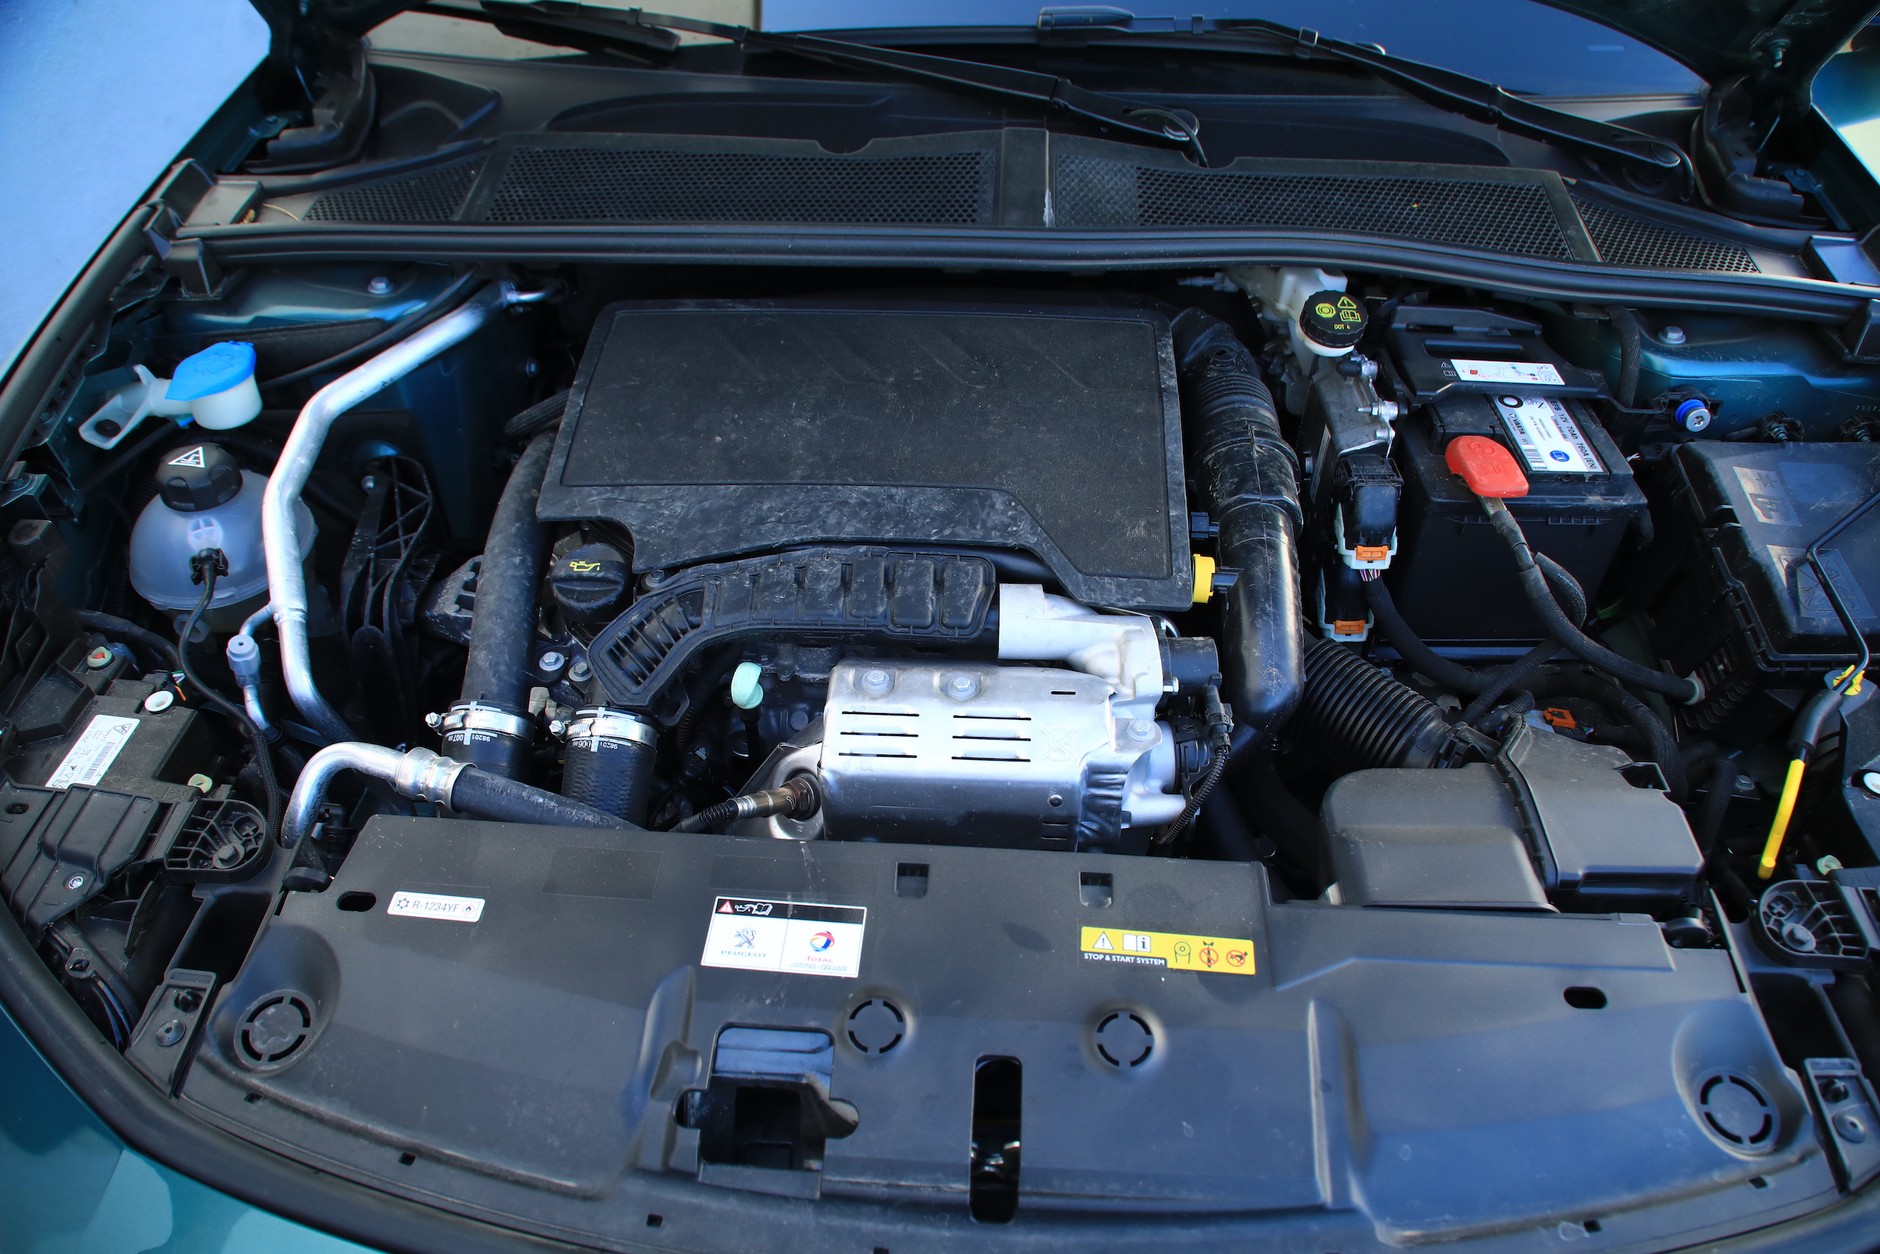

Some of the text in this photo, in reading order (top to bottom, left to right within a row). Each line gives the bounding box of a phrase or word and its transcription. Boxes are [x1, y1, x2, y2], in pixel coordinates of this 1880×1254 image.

[1512, 418, 1526, 436] VARTA
[1559, 413, 1570, 424] 12V
[1566, 425, 1579, 440] 70Ah
[1576, 442, 1590, 460] 760A
[412, 899, 460, 912] R-1234YF
[721, 949, 768, 958] PEUGEOT
[806, 955, 833, 964] TOTAL
[1084, 952, 1104, 960] STOP
[1111, 955, 1136, 963] START
[1136, 957, 1166, 966] SYSTEM
